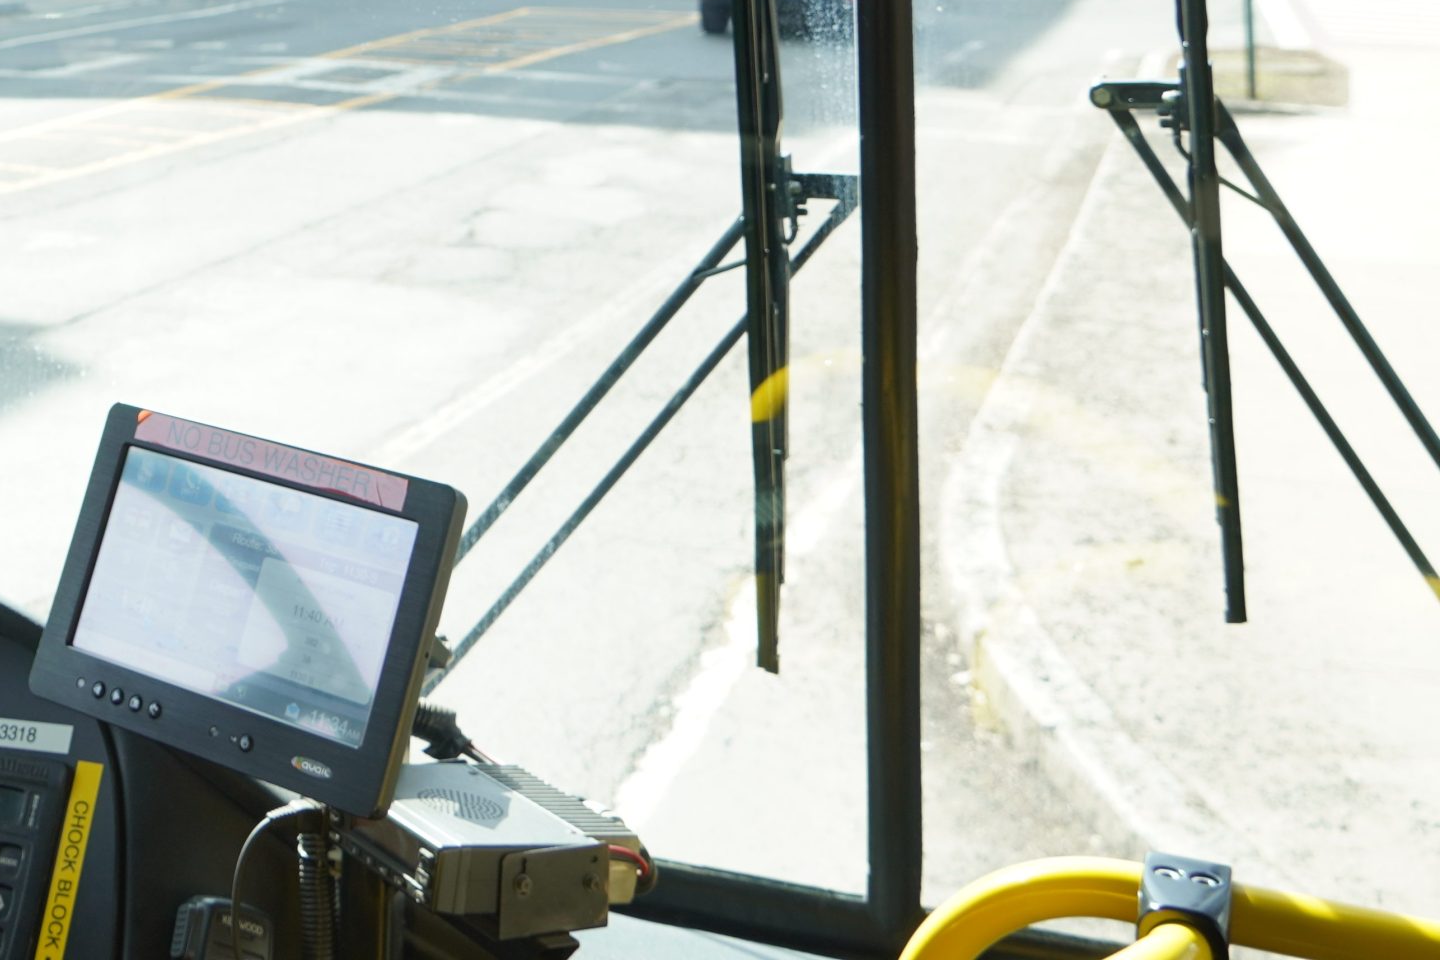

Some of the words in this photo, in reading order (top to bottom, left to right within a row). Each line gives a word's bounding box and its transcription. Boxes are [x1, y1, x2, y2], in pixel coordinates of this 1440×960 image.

[166, 420, 202, 453] NO
[208, 431, 257, 467] BUS
[263, 445, 372, 497] WASHER
[310, 709, 349, 735] 11:34
[61, 799, 91, 872] CHOCK
[43, 879, 73, 952] BLOCK
[222, 914, 264, 937] KEWOOD
